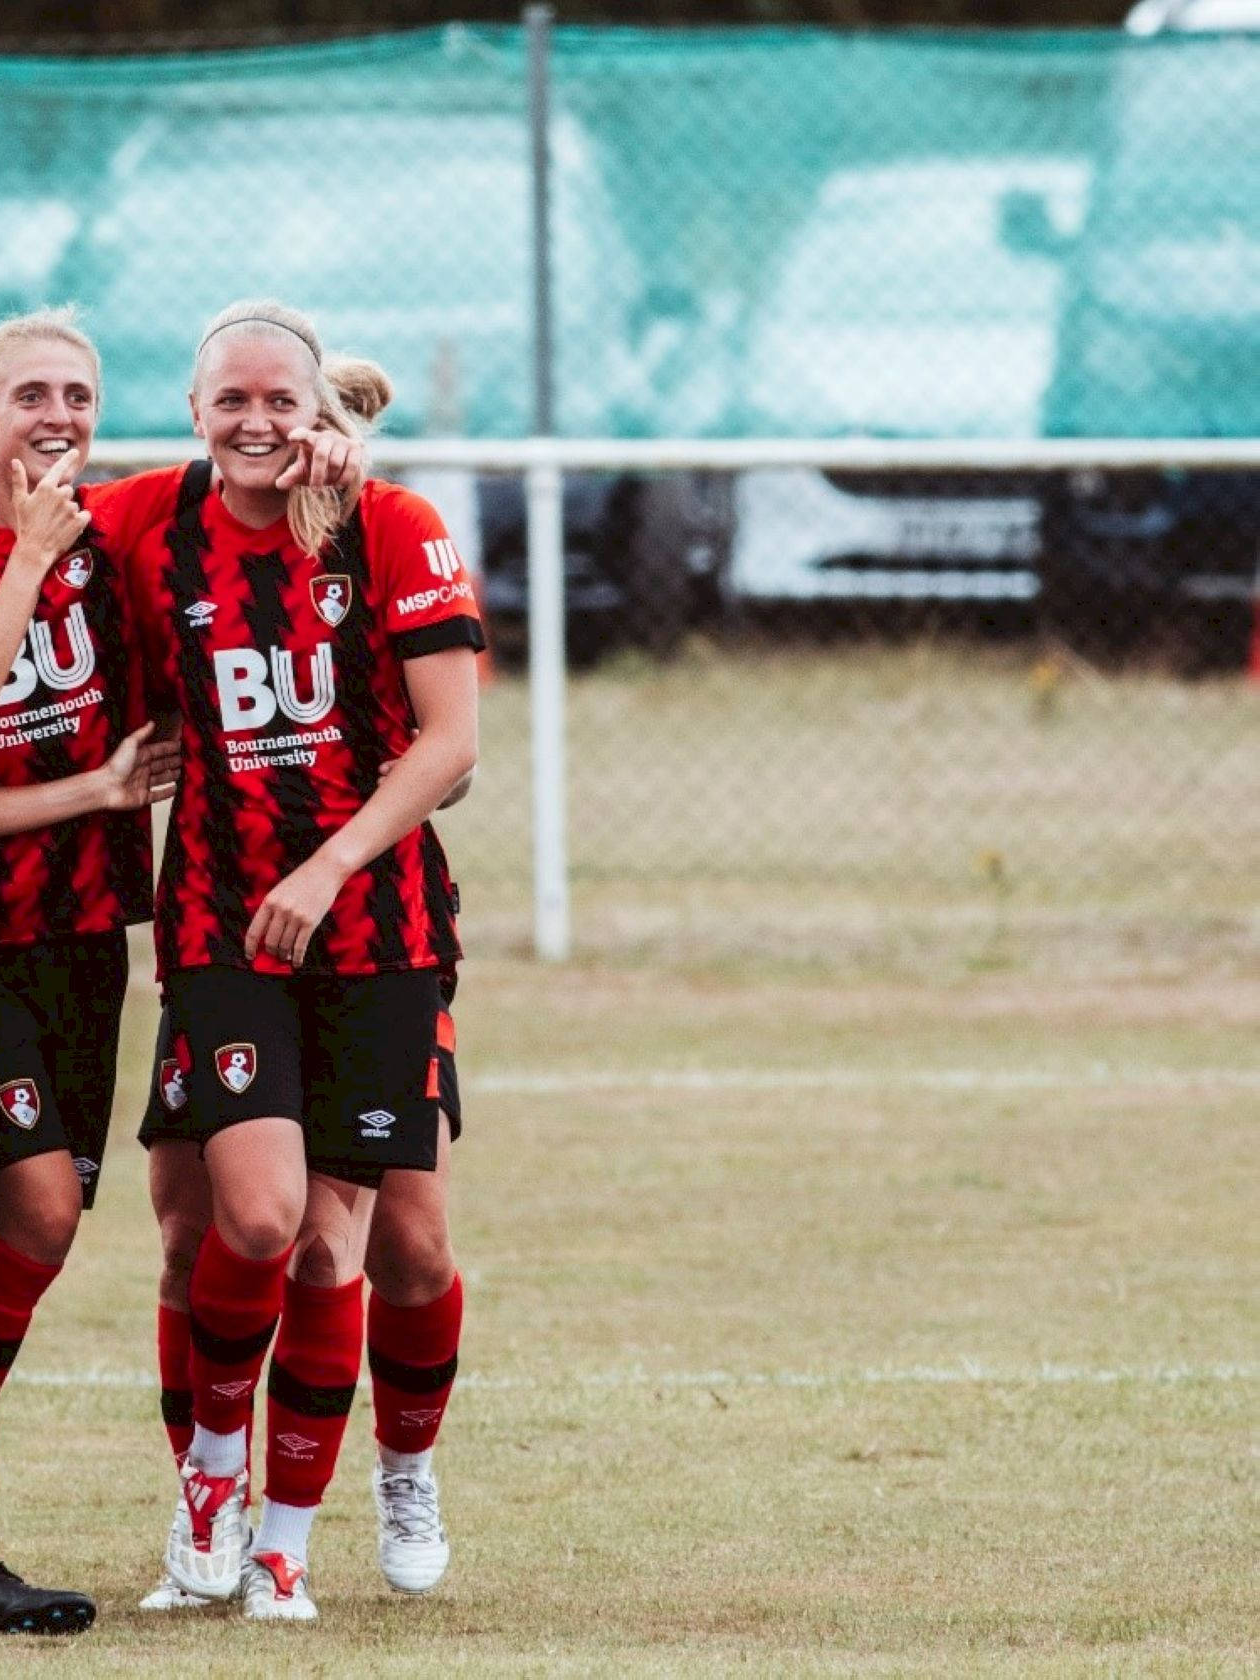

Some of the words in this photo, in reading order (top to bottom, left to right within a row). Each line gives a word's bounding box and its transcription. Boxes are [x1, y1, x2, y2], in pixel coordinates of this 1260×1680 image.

[213, 641, 337, 732] BU
[224, 725, 343, 755] Bournemouth
[228, 750, 318, 773] University
